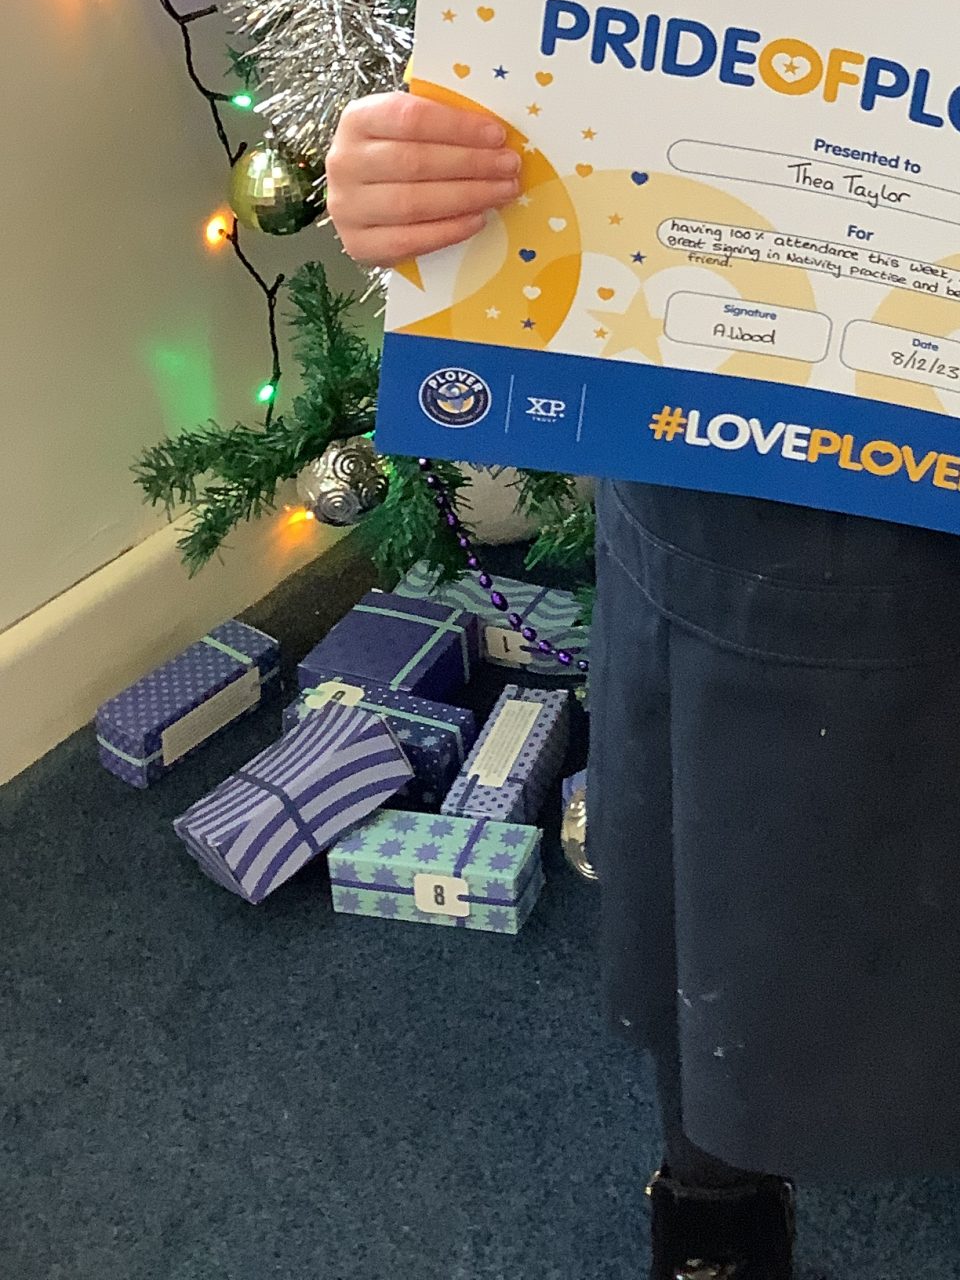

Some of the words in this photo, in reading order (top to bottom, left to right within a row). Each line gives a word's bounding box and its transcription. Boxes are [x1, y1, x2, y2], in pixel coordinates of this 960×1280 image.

[814, 138, 900, 169] Presented
[904, 158, 922, 174] to
[787, 162, 834, 191] Thea
[843, 174, 911, 208] Taylor
[671, 220, 722, 241] having
[774, 236, 859, 261] attendance
[868, 251, 900, 269] this
[847, 224, 875, 241] For
[667, 235, 706, 250] great
[712, 243, 761, 262] signing
[767, 249, 780, 260] in
[787, 253, 842, 279] Nativity
[850, 266, 907, 284] practise
[913, 278, 939, 293] and
[724, 304, 777, 321] Signature
[912, 337, 939, 352] Date
[890, 350, 960, 380] 8/12/23
[428, 371, 484, 393] PLOVER
[434, 884, 445, 906] 8
